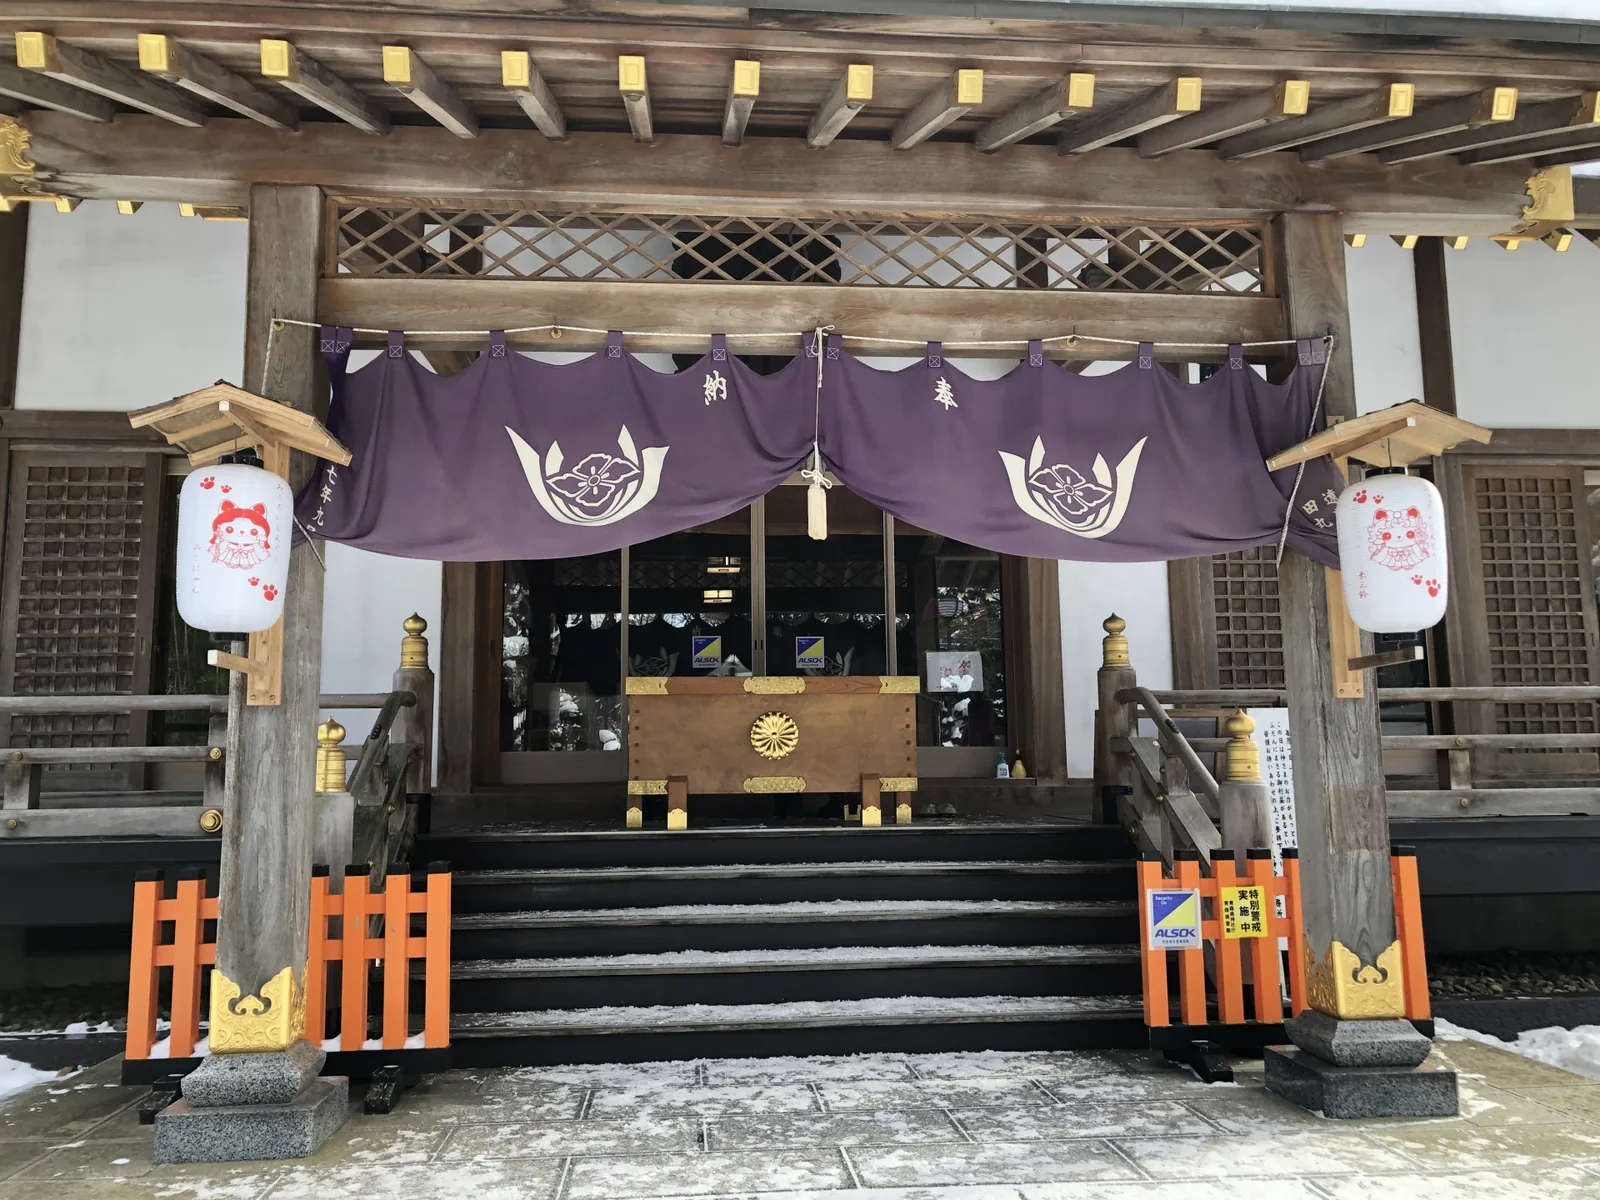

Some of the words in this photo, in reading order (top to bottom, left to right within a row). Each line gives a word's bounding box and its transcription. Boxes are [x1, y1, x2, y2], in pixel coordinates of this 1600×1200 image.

[702, 369, 727, 406] 納
[934, 376, 959, 411] 奉
[1238, 890, 1251, 932] 実施中
[1249, 889, 1262, 932] 特別警戒
[1155, 928, 1196, 938] ALSOK
